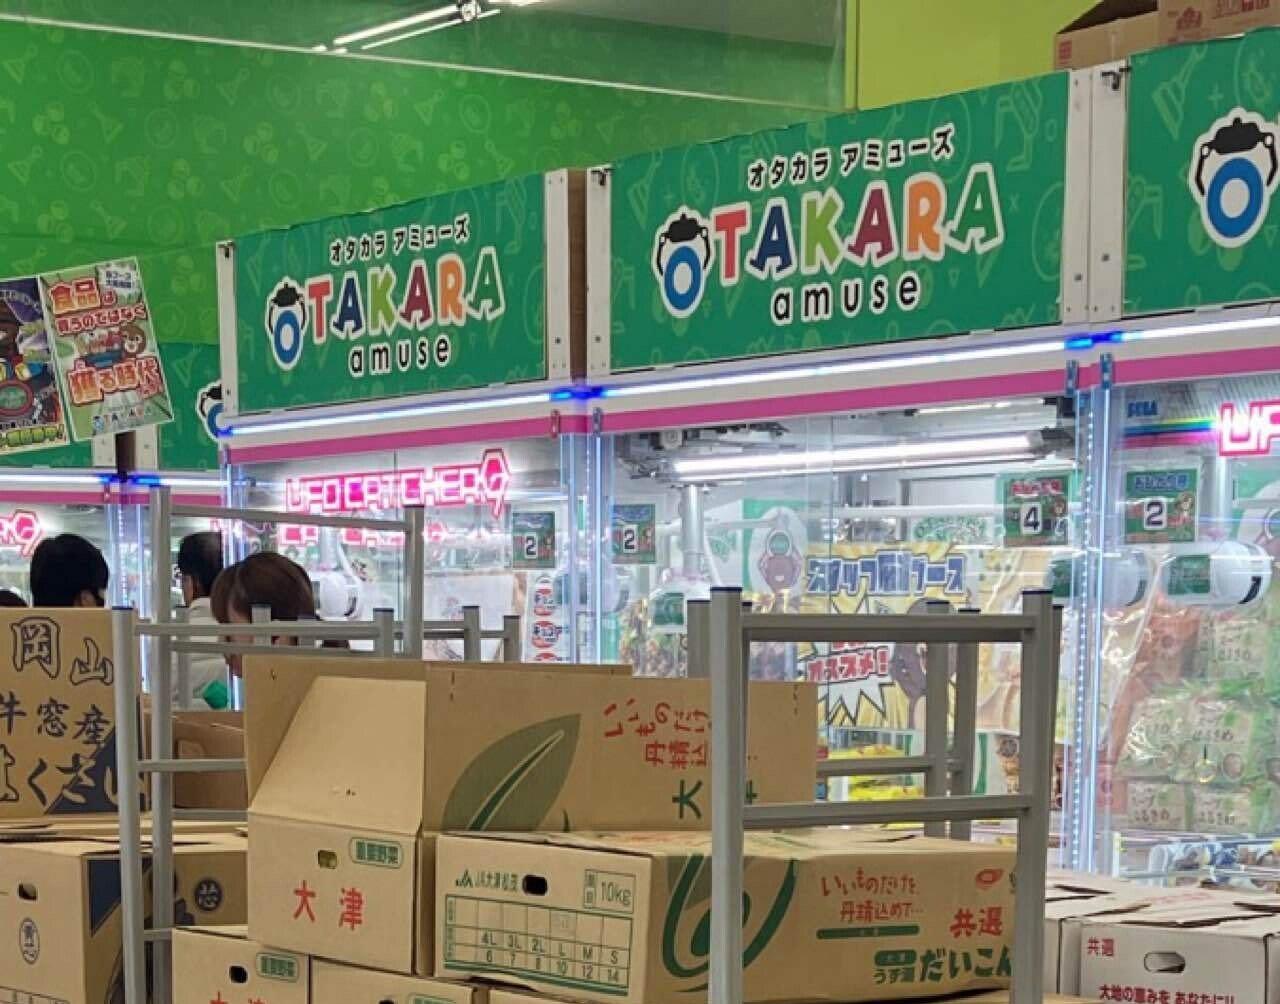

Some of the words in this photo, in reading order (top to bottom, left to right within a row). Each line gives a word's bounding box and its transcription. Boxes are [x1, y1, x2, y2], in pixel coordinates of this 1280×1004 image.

[749, 151, 830, 189] オタカラ
[841, 126, 954, 173] アミューズ
[330, 233, 386, 262] オタカラ
[392, 214, 470, 252] アミューズ
[662, 163, 1004, 313] OTAKARA
[268, 248, 505, 366] OTAKARA
[773, 275, 919, 321] amuse
[351, 338, 450, 375] amuse
[286, 476, 341, 512] UFO
[344, 464, 481, 510] CATCHER
[1023, 506, 1039, 533] 4
[1146, 501, 1163, 526] 2
[623, 527, 636, 550] 2
[11, 616, 115, 687] 岡山
[293, 879, 364, 932] 大津
[600, 880, 632, 906] 10kg
[949, 906, 1004, 939] 共選
